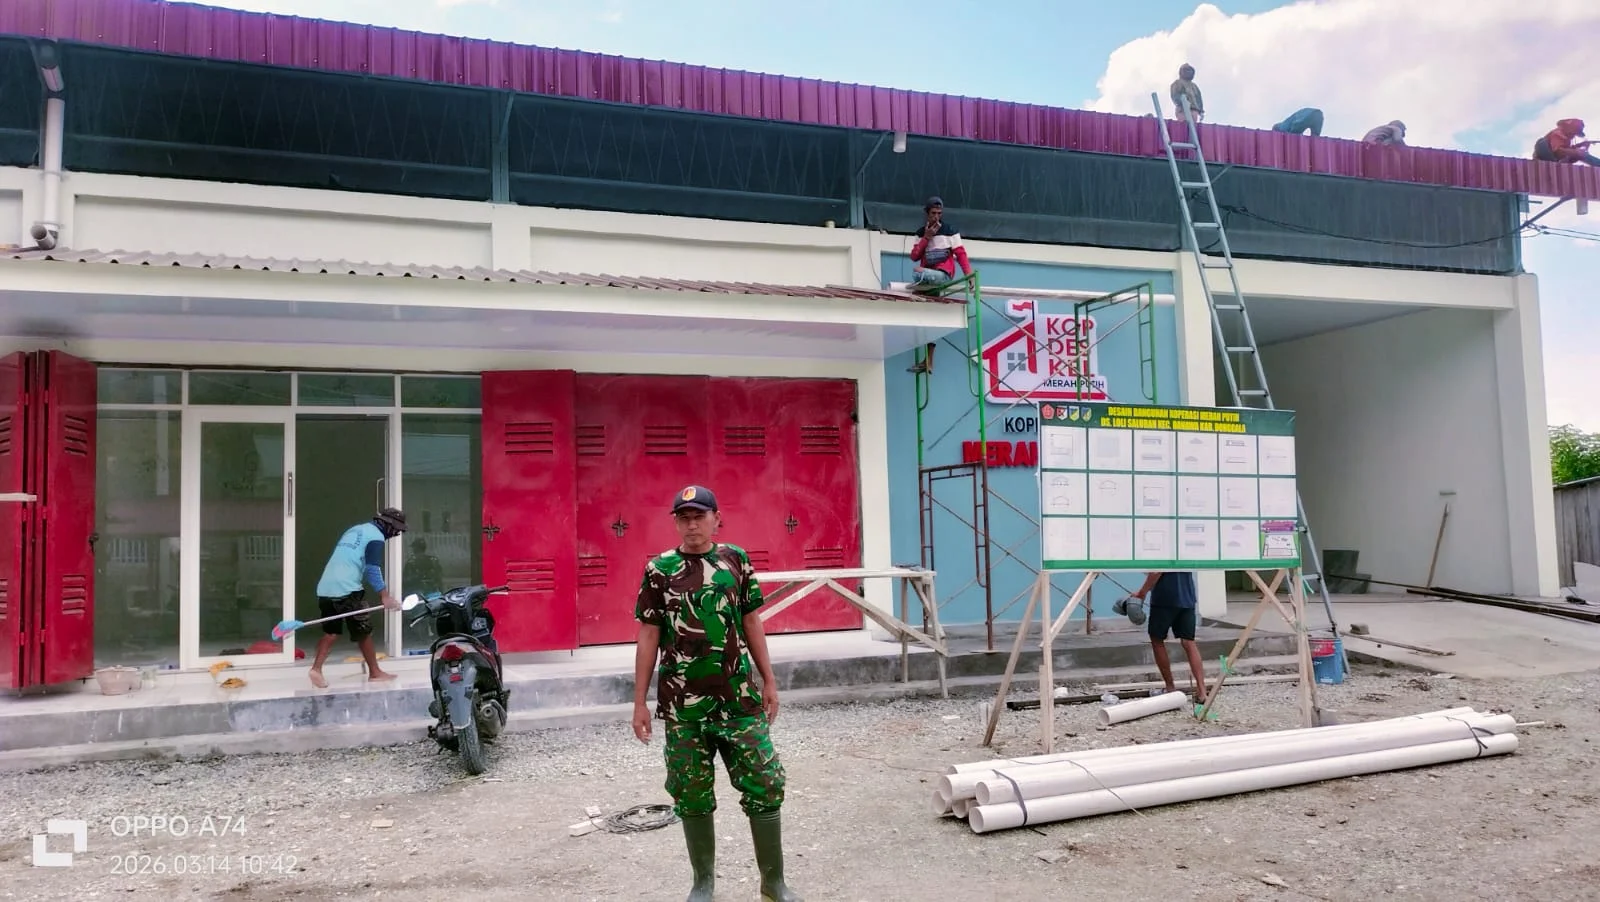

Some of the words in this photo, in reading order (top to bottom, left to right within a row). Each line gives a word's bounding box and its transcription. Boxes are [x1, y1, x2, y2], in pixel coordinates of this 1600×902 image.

[1046, 317, 1094, 336] KOP
[1048, 338, 1090, 356] DES
[1049, 359, 1095, 377] KEL
[1044, 379, 1076, 388] MERAH
[1113, 417, 1126, 427] LOLI
